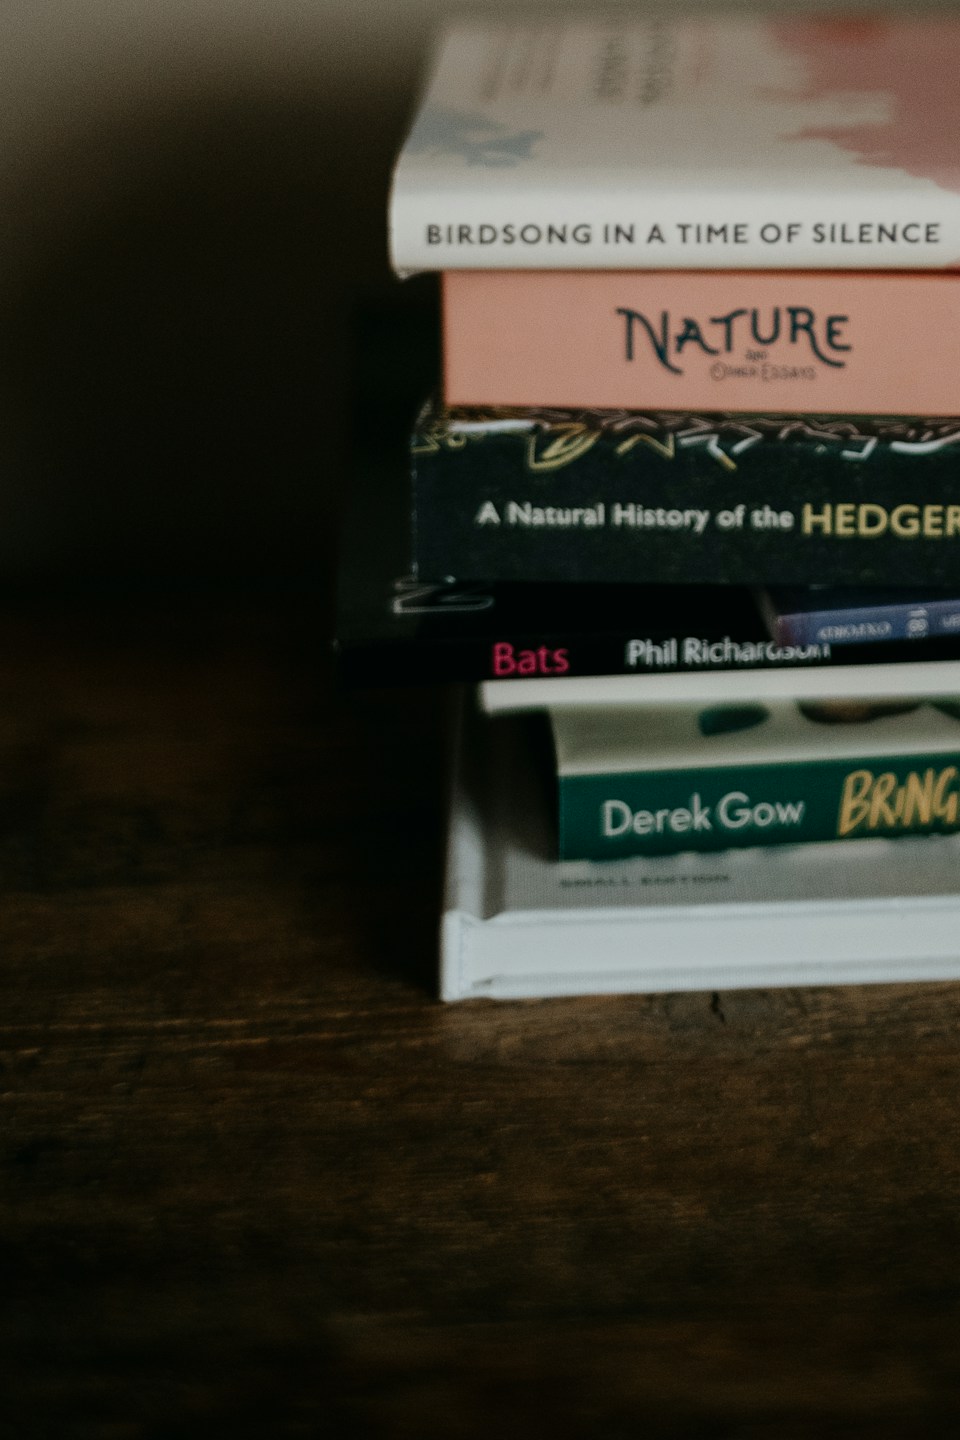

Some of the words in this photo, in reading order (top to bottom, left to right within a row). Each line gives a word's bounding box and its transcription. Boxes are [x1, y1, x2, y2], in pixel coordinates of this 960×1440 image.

[426, 223, 593, 245] BIRDSONG
[602, 223, 635, 244] IN
[646, 223, 665, 244] A
[676, 222, 749, 243] TIME
[759, 223, 801, 243] OF
[812, 222, 941, 243] SILENCE
[616, 307, 852, 375] NATURE
[475, 500, 501, 525] A
[506, 500, 605, 527] Natural
[612, 502, 710, 534] History
[716, 503, 746, 530] of
[751, 504, 795, 531] the
[491, 640, 571, 677] Bats
[625, 637, 678, 667] Phil
[603, 792, 712, 838] Derek
[717, 791, 806, 830] Gow
